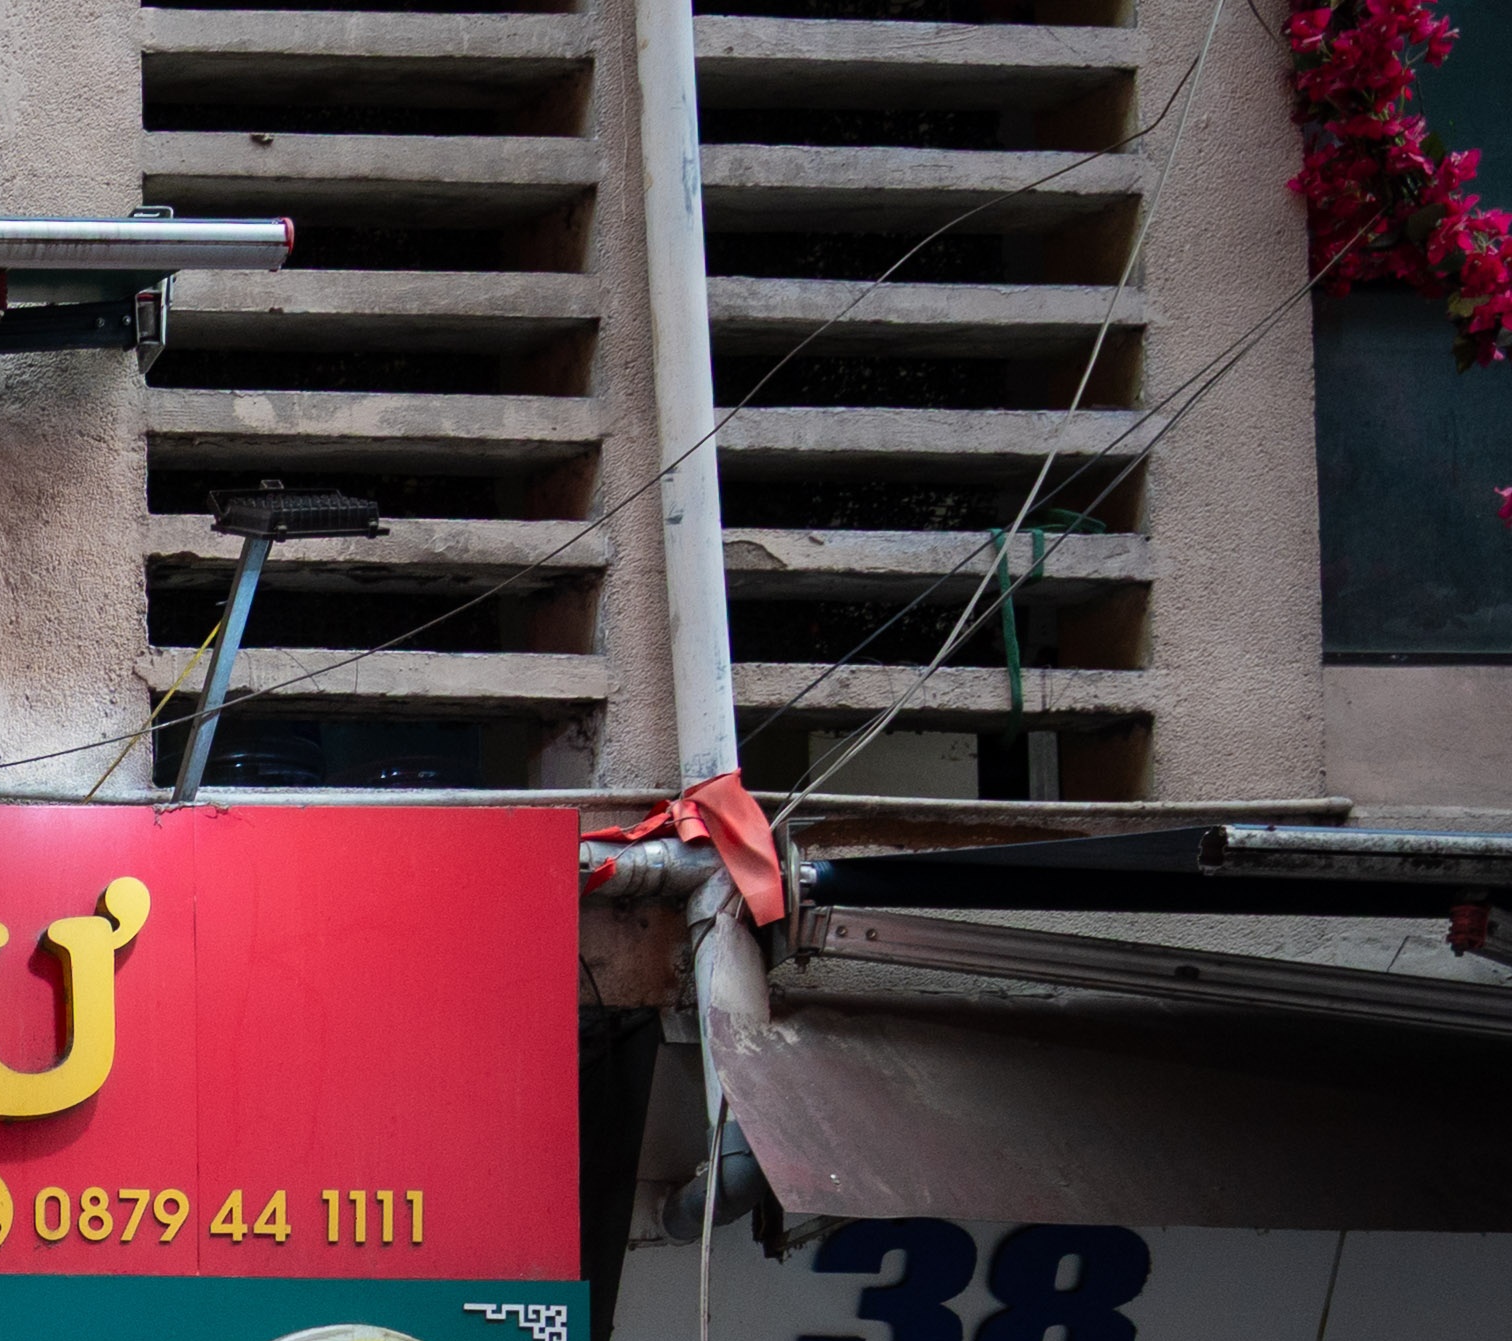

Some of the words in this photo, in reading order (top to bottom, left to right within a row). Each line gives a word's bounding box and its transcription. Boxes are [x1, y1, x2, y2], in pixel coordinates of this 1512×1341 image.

[32, 1184, 192, 1244] 0879
[208, 1187, 293, 1244] 44
[320, 1187, 426, 1245] 1111
